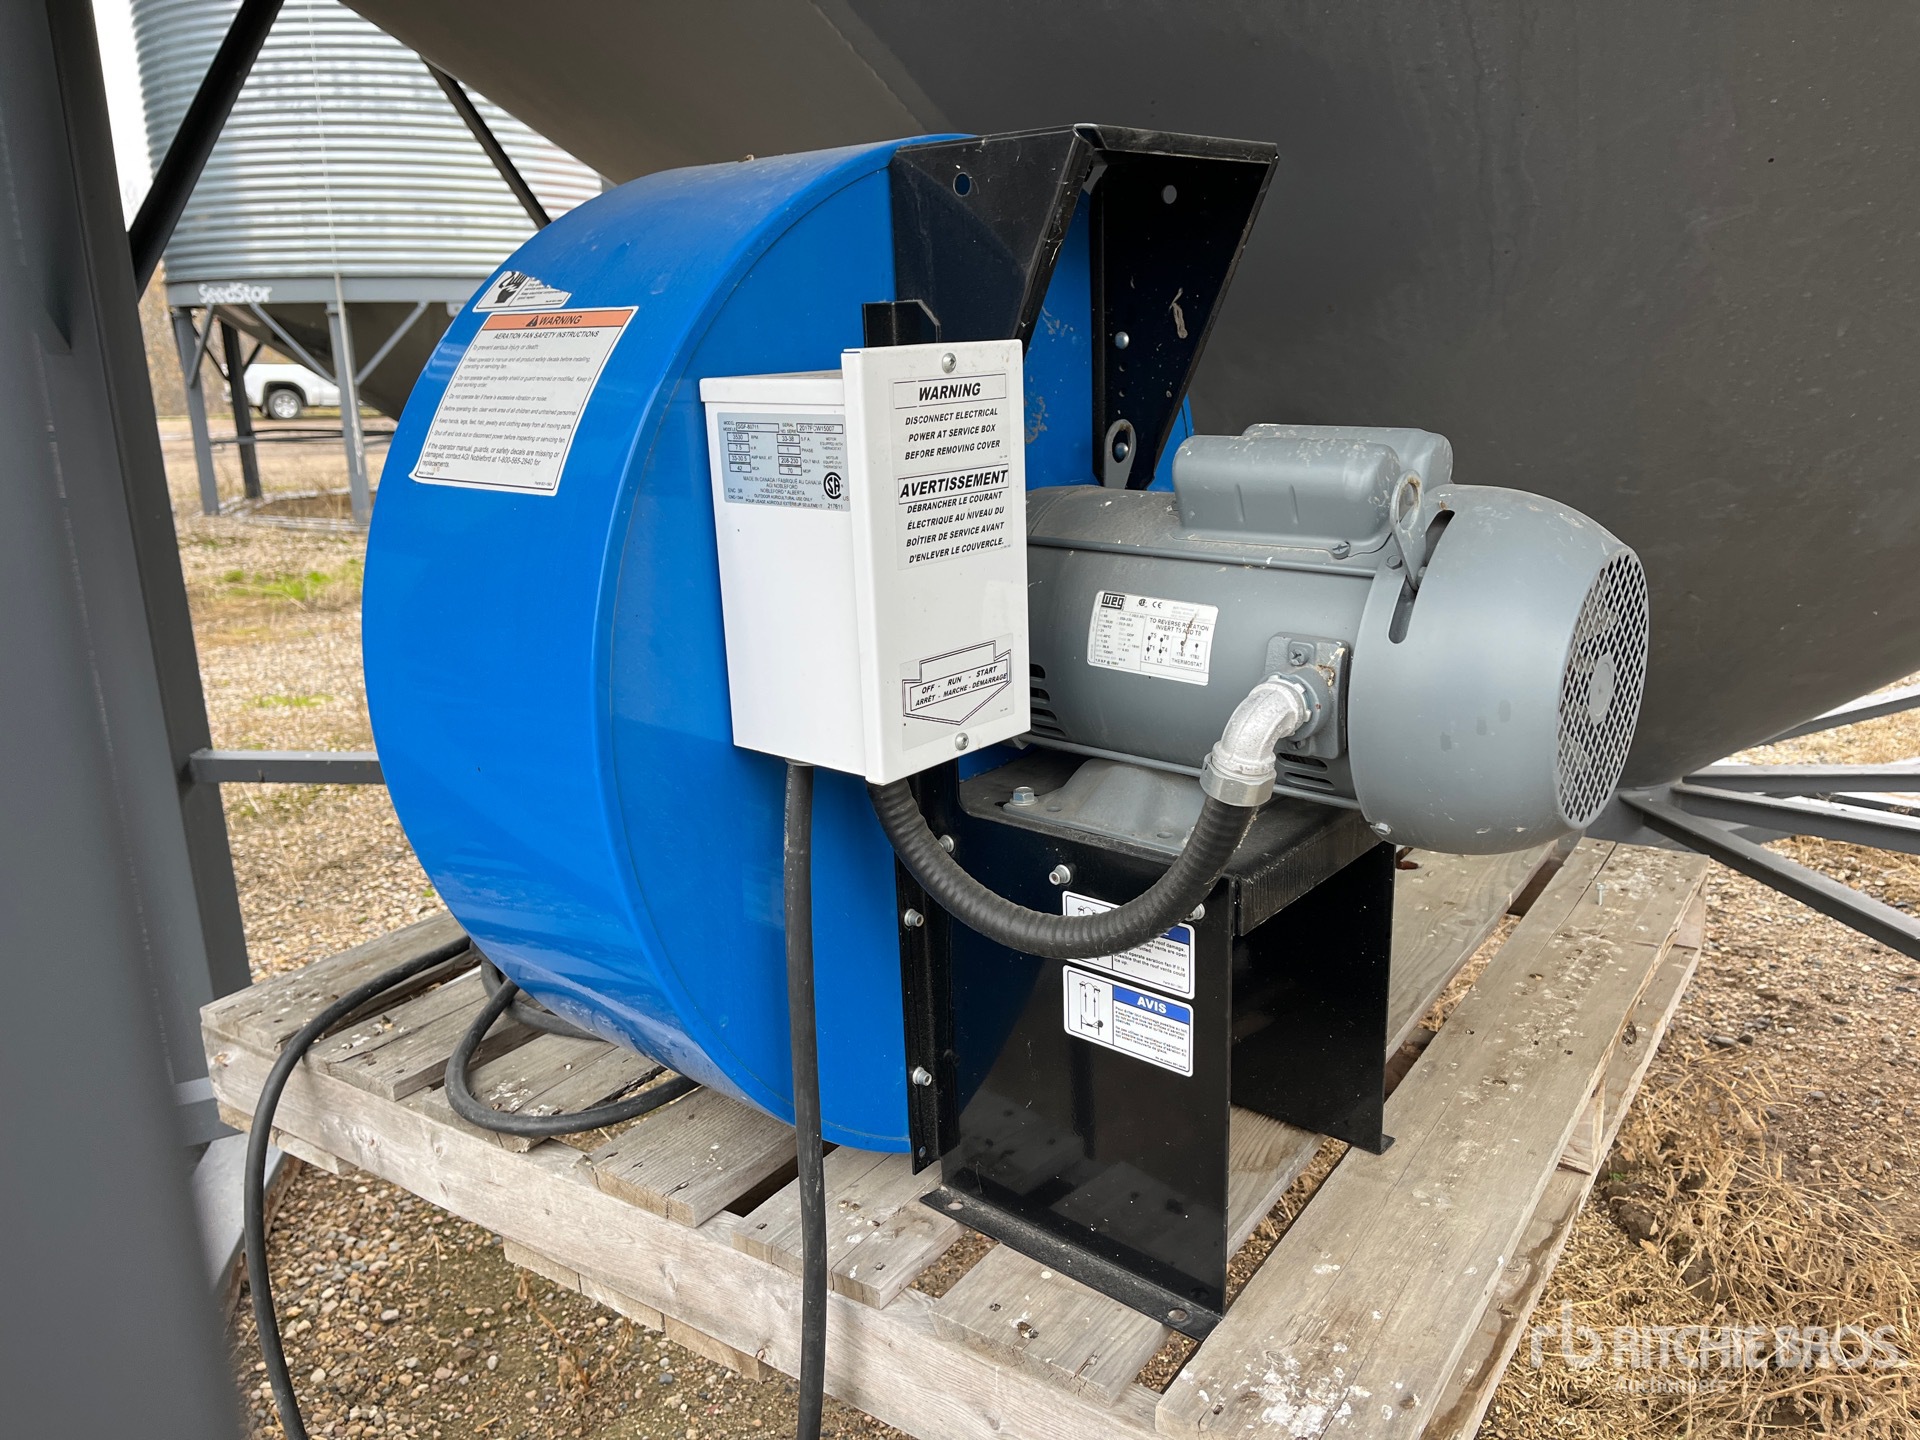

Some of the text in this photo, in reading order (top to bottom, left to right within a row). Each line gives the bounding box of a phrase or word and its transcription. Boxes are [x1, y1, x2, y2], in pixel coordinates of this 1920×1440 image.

[198, 283, 272, 303] SeedStor
[538, 316, 582, 326] WARNING
[919, 382, 981, 401] WARNING
[905, 408, 998, 425] DISCONNECT ELECTRICAL
[908, 424, 996, 442] POWER AT SERVICE BOX
[535, 450, 553, 459] missing
[905, 440, 1000, 460] BEFORE REMOVING COVER
[900, 470, 1008, 498] AVERTISSEMENT
[907, 491, 1003, 514] DÉBRANCHER LE COURANT
[907, 506, 1004, 530] ÉLECTRIQUE AU NIVEAU DU
[938, 532, 948, 541] DE
[950, 526, 979, 539] SERVICE
[981, 522, 1004, 533] AVANT
[909, 537, 1004, 564] D'ENLEVER LE COUVERCLE.
[1158, 619, 1181, 627] REVERSE
[1172, 658, 1202, 667] THERMOSTAT
[921, 684, 935, 694] OFF
[947, 676, 962, 686] RUN
[976, 666, 997, 677] START
[915, 694, 936, 706] ARRÊT
[943, 685, 968, 698] MARCHE
[1166, 943, 1185, 952] damage.
[1137, 996, 1166, 1014] AVIS
